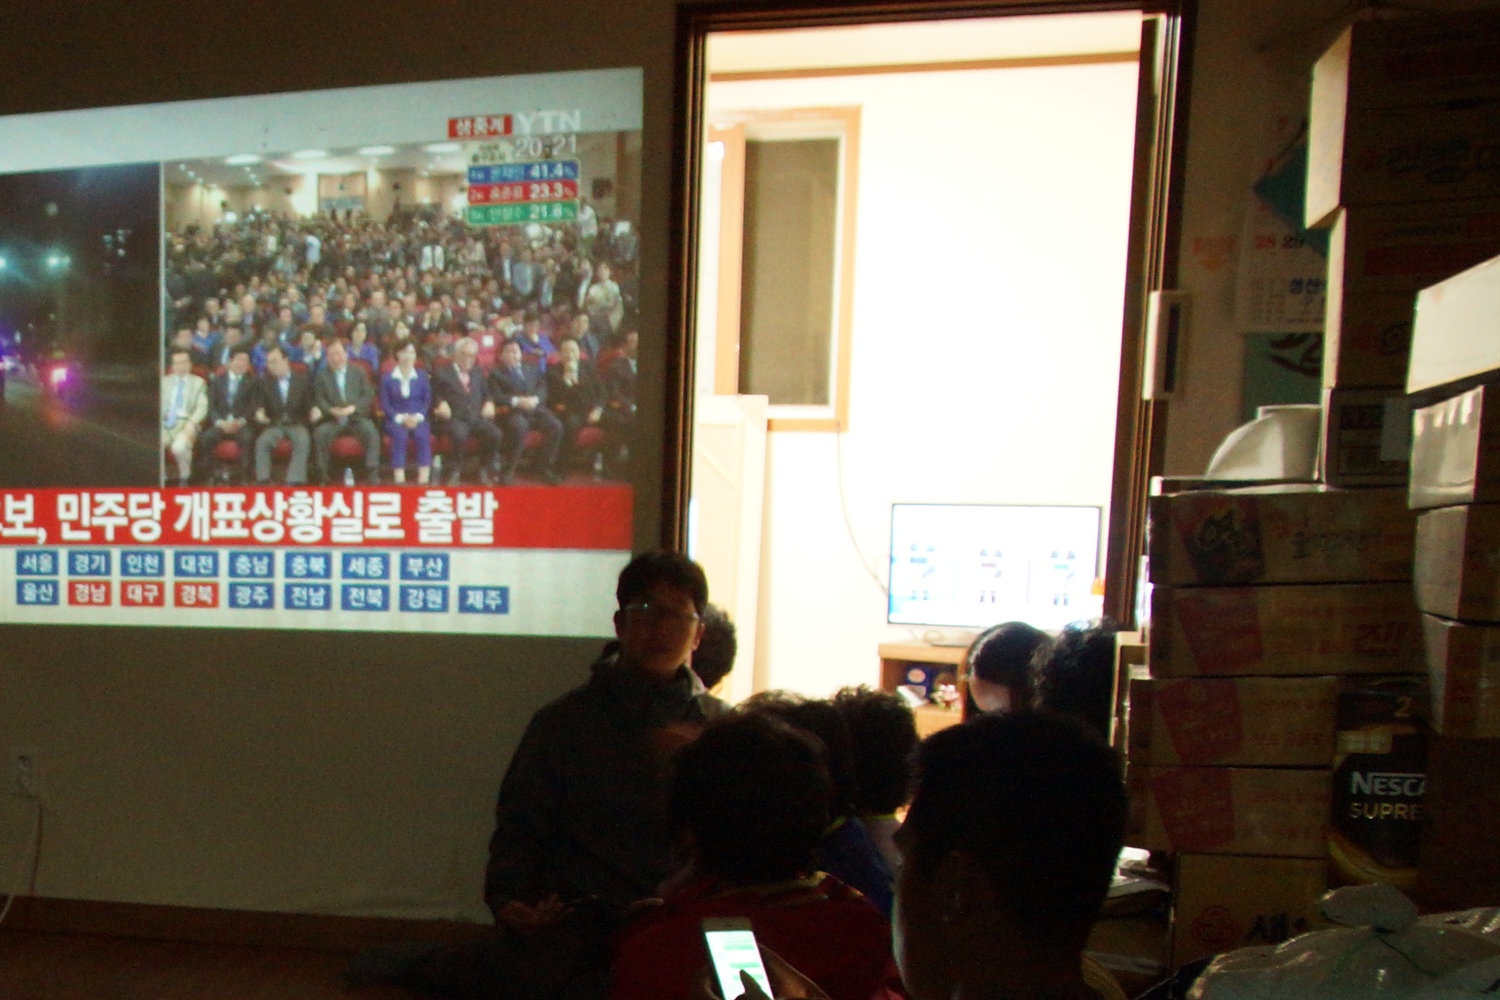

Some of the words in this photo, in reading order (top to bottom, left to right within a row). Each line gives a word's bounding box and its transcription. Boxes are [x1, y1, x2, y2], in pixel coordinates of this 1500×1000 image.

[515, 108, 581, 135] YTN
[57, 490, 165, 542] 민주당
[173, 490, 406, 544] 개표상황실로
[414, 489, 499, 544] 출발
[22, 551, 53, 573] 서울
[74, 552, 106, 572] 경기
[127, 552, 160, 575] 인천
[181, 554, 214, 575] 대전
[235, 555, 269, 576] 충남
[349, 556, 384, 578] 세종
[408, 557, 444, 578] 부산
[22, 582, 54, 604] 울산
[74, 582, 106, 604] 경남
[127, 584, 160, 605] 대구
[180, 584, 214, 606] 경북
[236, 585, 269, 606] 광주
[291, 586, 326, 608] 전남
[349, 586, 384, 608] 전북
[408, 588, 444, 610] 강원
[465, 589, 502, 611] 제주
